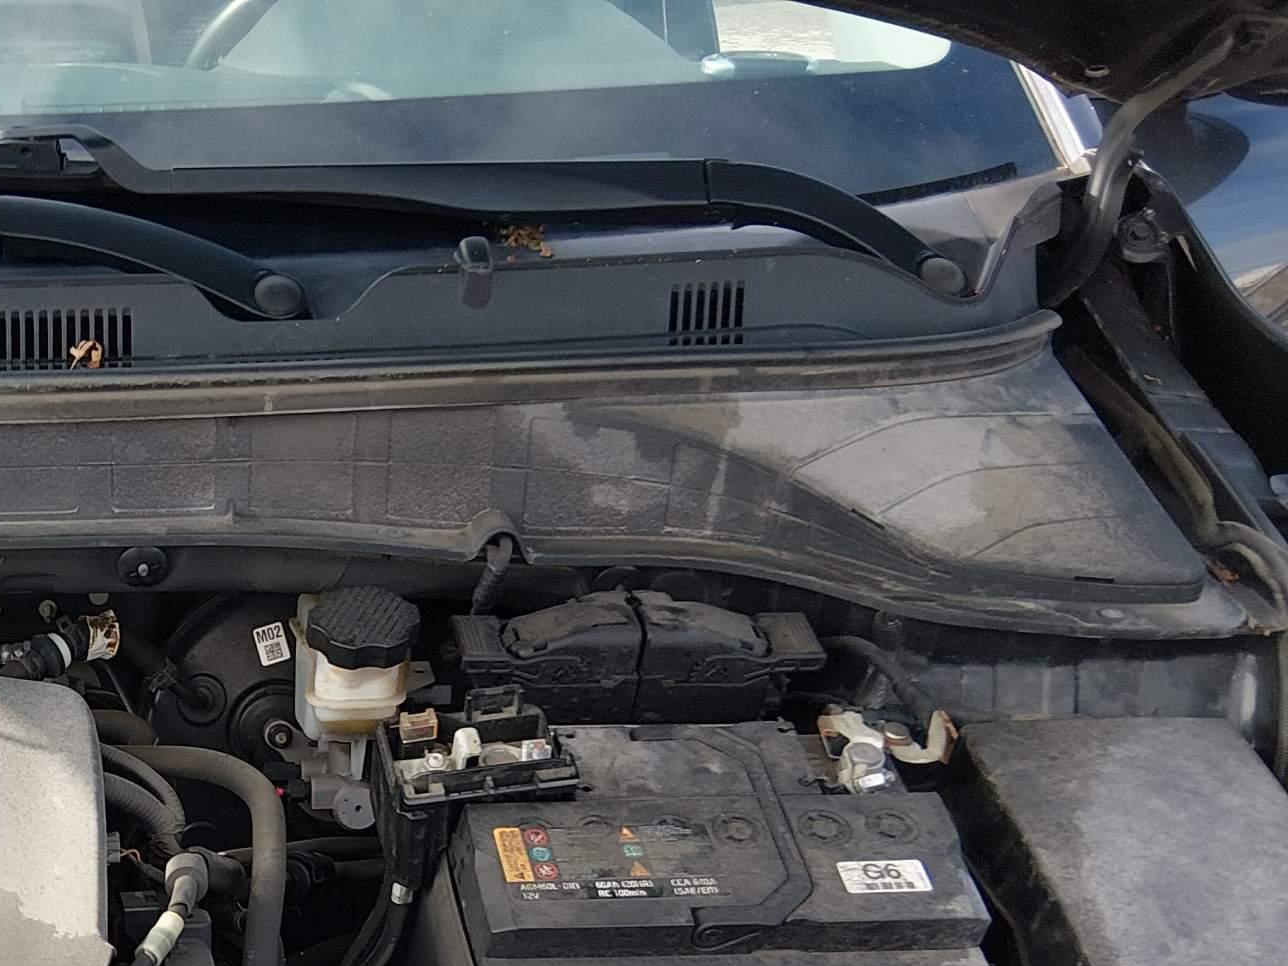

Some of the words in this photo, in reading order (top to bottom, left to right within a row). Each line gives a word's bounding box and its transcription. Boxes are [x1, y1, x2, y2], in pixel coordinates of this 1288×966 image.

[255, 625, 283, 644] M02
[863, 863, 901, 879] G6
[522, 892, 539, 900] 12V
